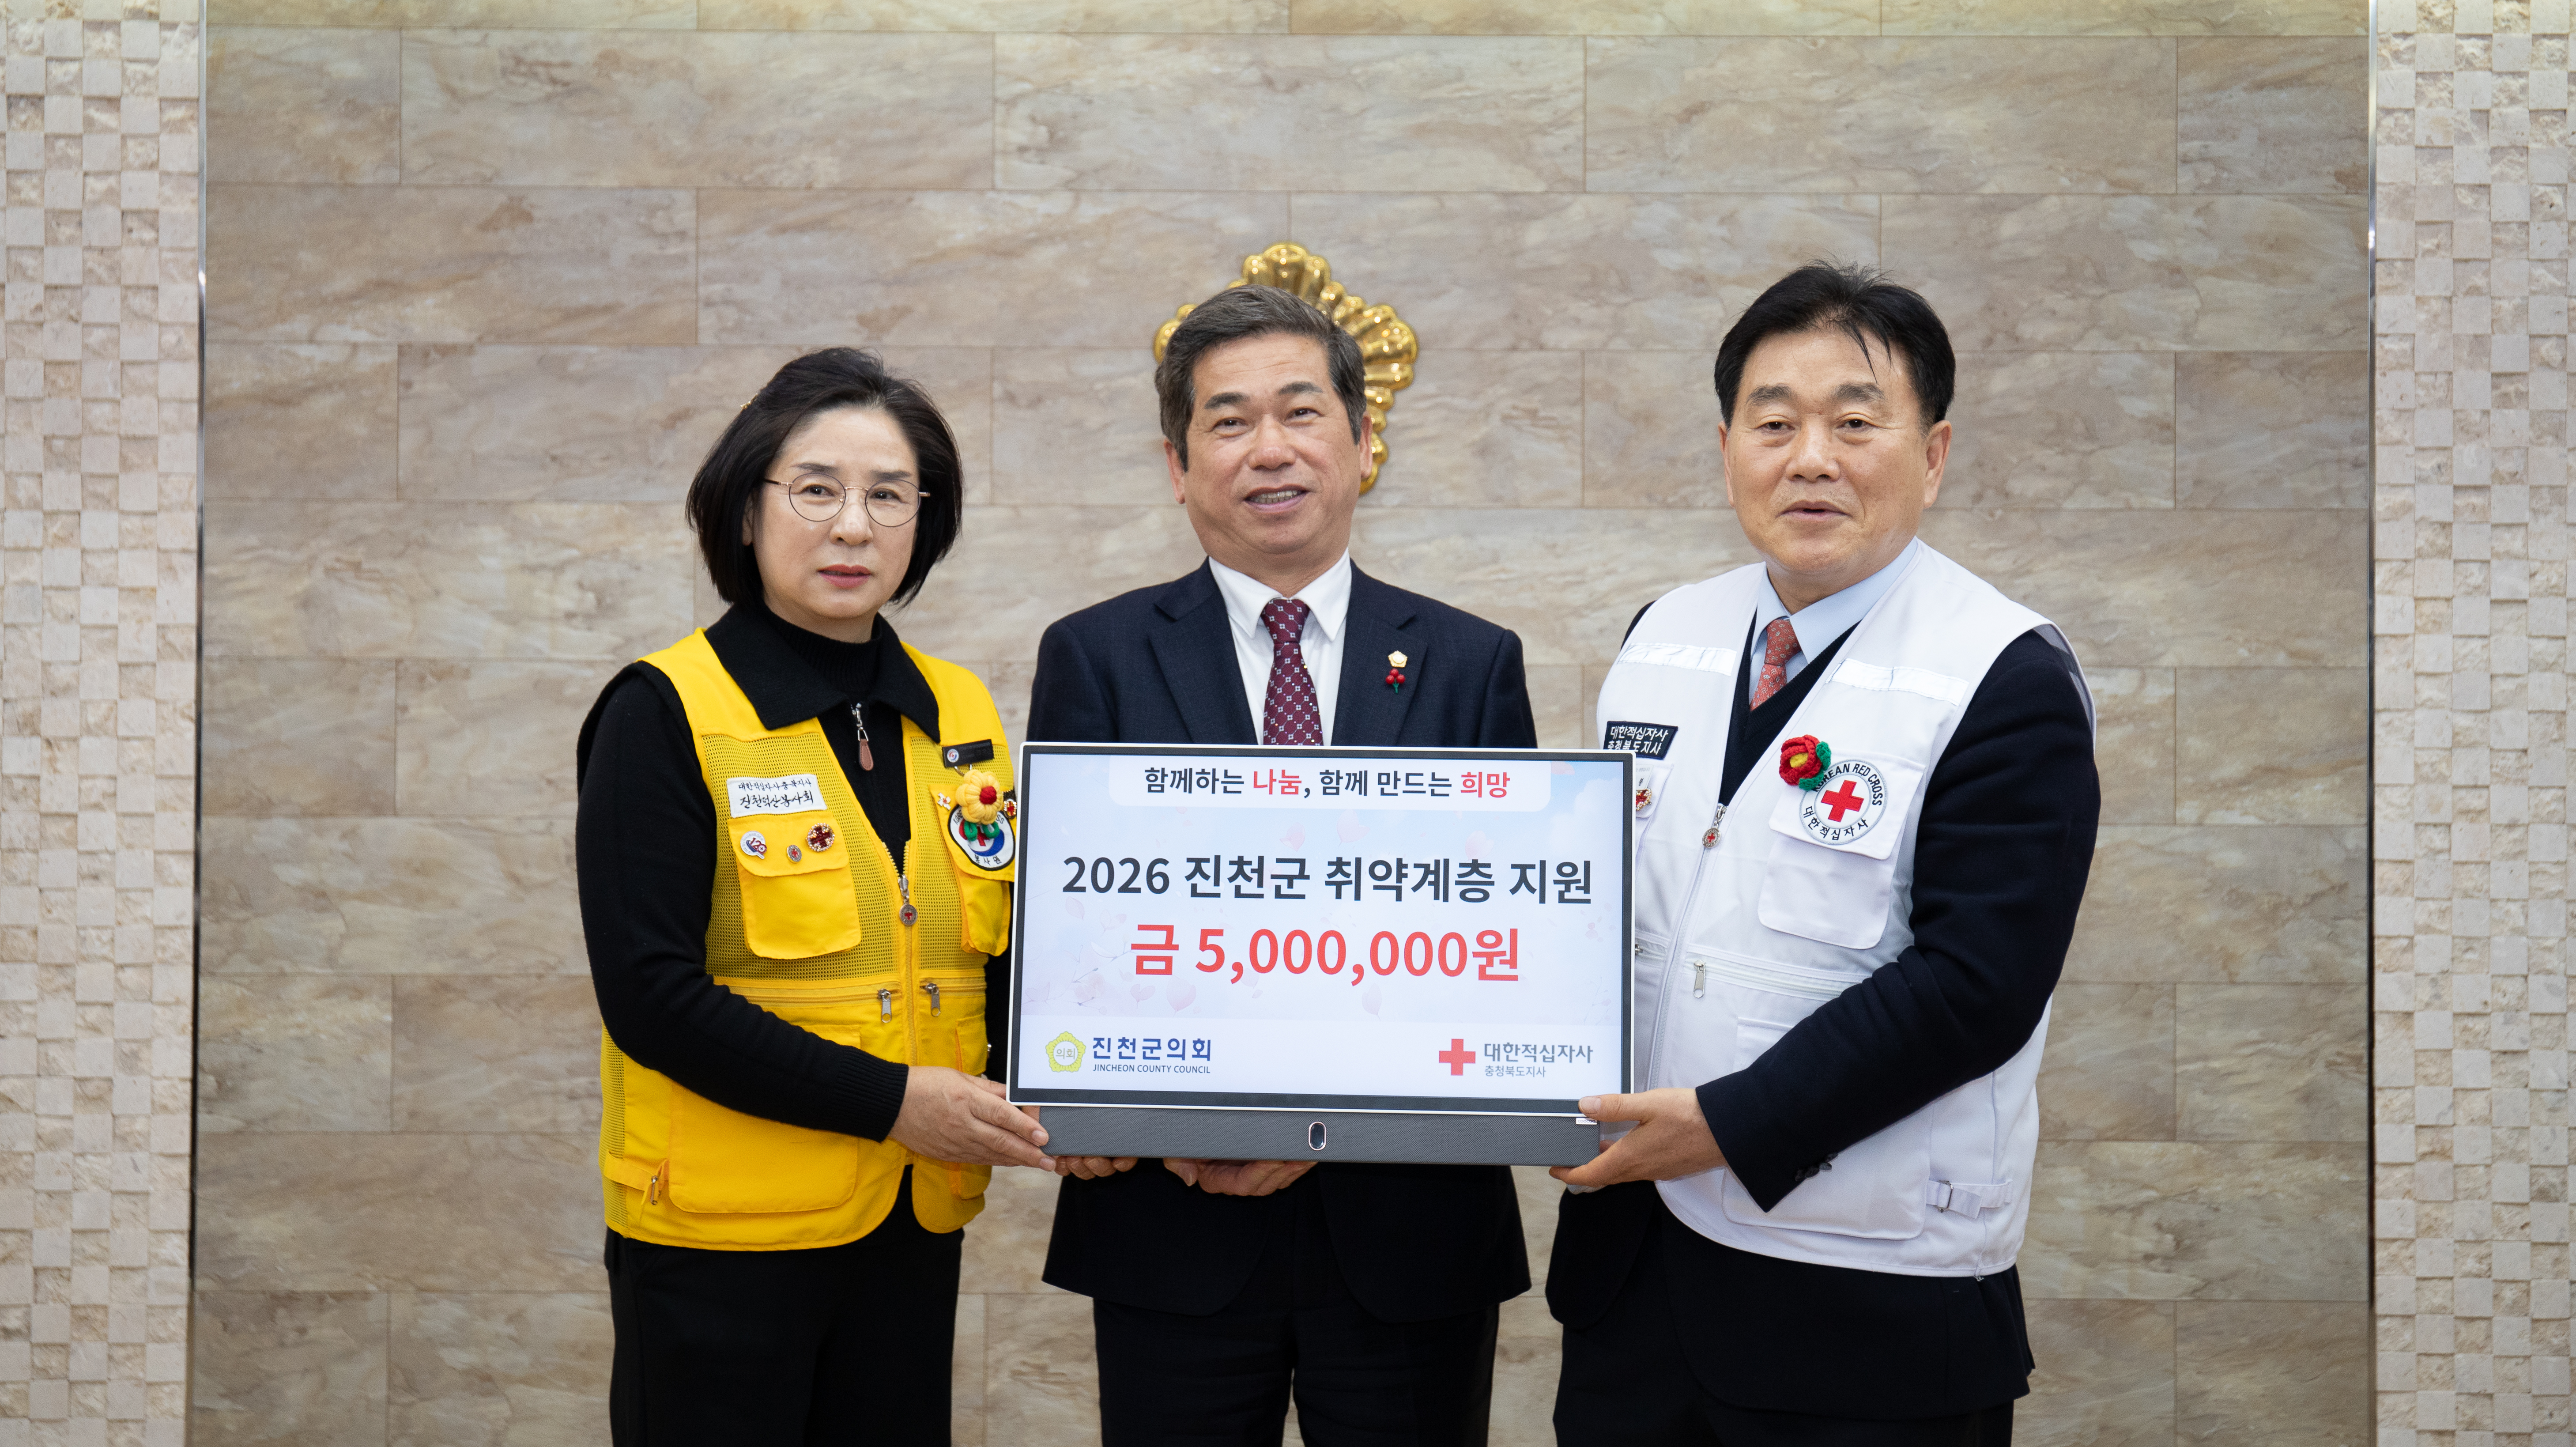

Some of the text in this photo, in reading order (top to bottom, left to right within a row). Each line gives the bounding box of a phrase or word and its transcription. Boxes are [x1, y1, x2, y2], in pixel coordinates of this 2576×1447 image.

[1610, 725, 1669, 742] 대한적십자사
[1145, 767, 1511, 799] 함께하는 나눔, 함께 만드는 희망
[1852, 763, 1871, 776] RED
[1868, 774, 1883, 806] CROSS
[1803, 806, 1868, 841] 대한적십자사
[1063, 854, 1592, 905] 2026 진천군 취약계층 지원
[1131, 924, 1520, 986] 금 5,000,000원
[1056, 1047, 1075, 1060] 의회
[1093, 1037, 1211, 1062] 진천군의회
[1484, 1042, 1594, 1064] 대한적십자사
[1093, 1064, 1211, 1074] JINCHEON COUNTY COUNCIL
[1485, 1065, 1546, 1078] 충청북도지사
